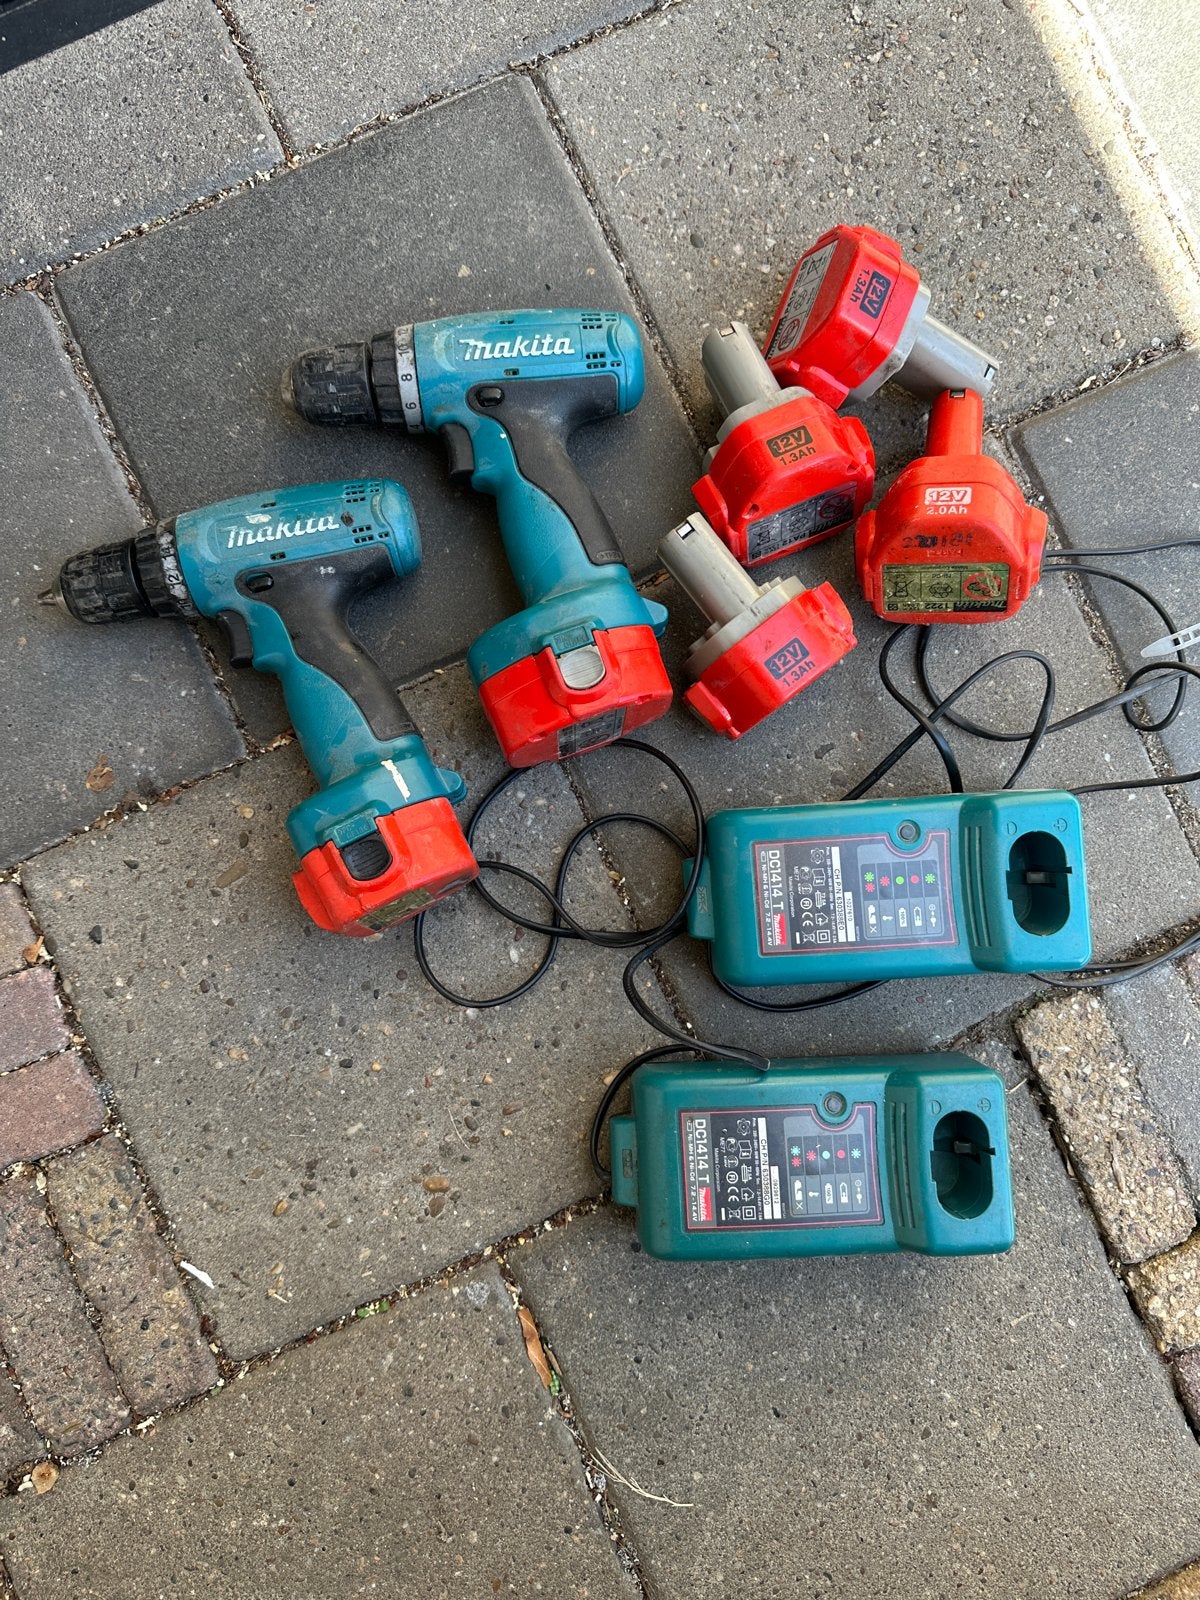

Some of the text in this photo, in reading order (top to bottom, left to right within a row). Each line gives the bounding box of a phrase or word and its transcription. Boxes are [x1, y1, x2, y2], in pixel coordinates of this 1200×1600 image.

[850, 269, 870, 303] 1.3Ah
[864, 278, 887, 315] 12V
[398, 338, 409, 356] 10
[401, 372, 413, 382] 8
[772, 429, 805, 453] 12V
[780, 446, 816, 466] 1.3Ah
[928, 489, 968, 502] 12V
[926, 506, 968, 515] 2.0Ah
[168, 573, 181, 588] 12
[770, 643, 802, 673] 12V
[783, 661, 816, 687] 1.3Ah
[769, 850, 783, 898] DC1414
[773, 901, 784, 910] T
[695, 1119, 708, 1169] DC1414
[699, 1174, 709, 1184] T
